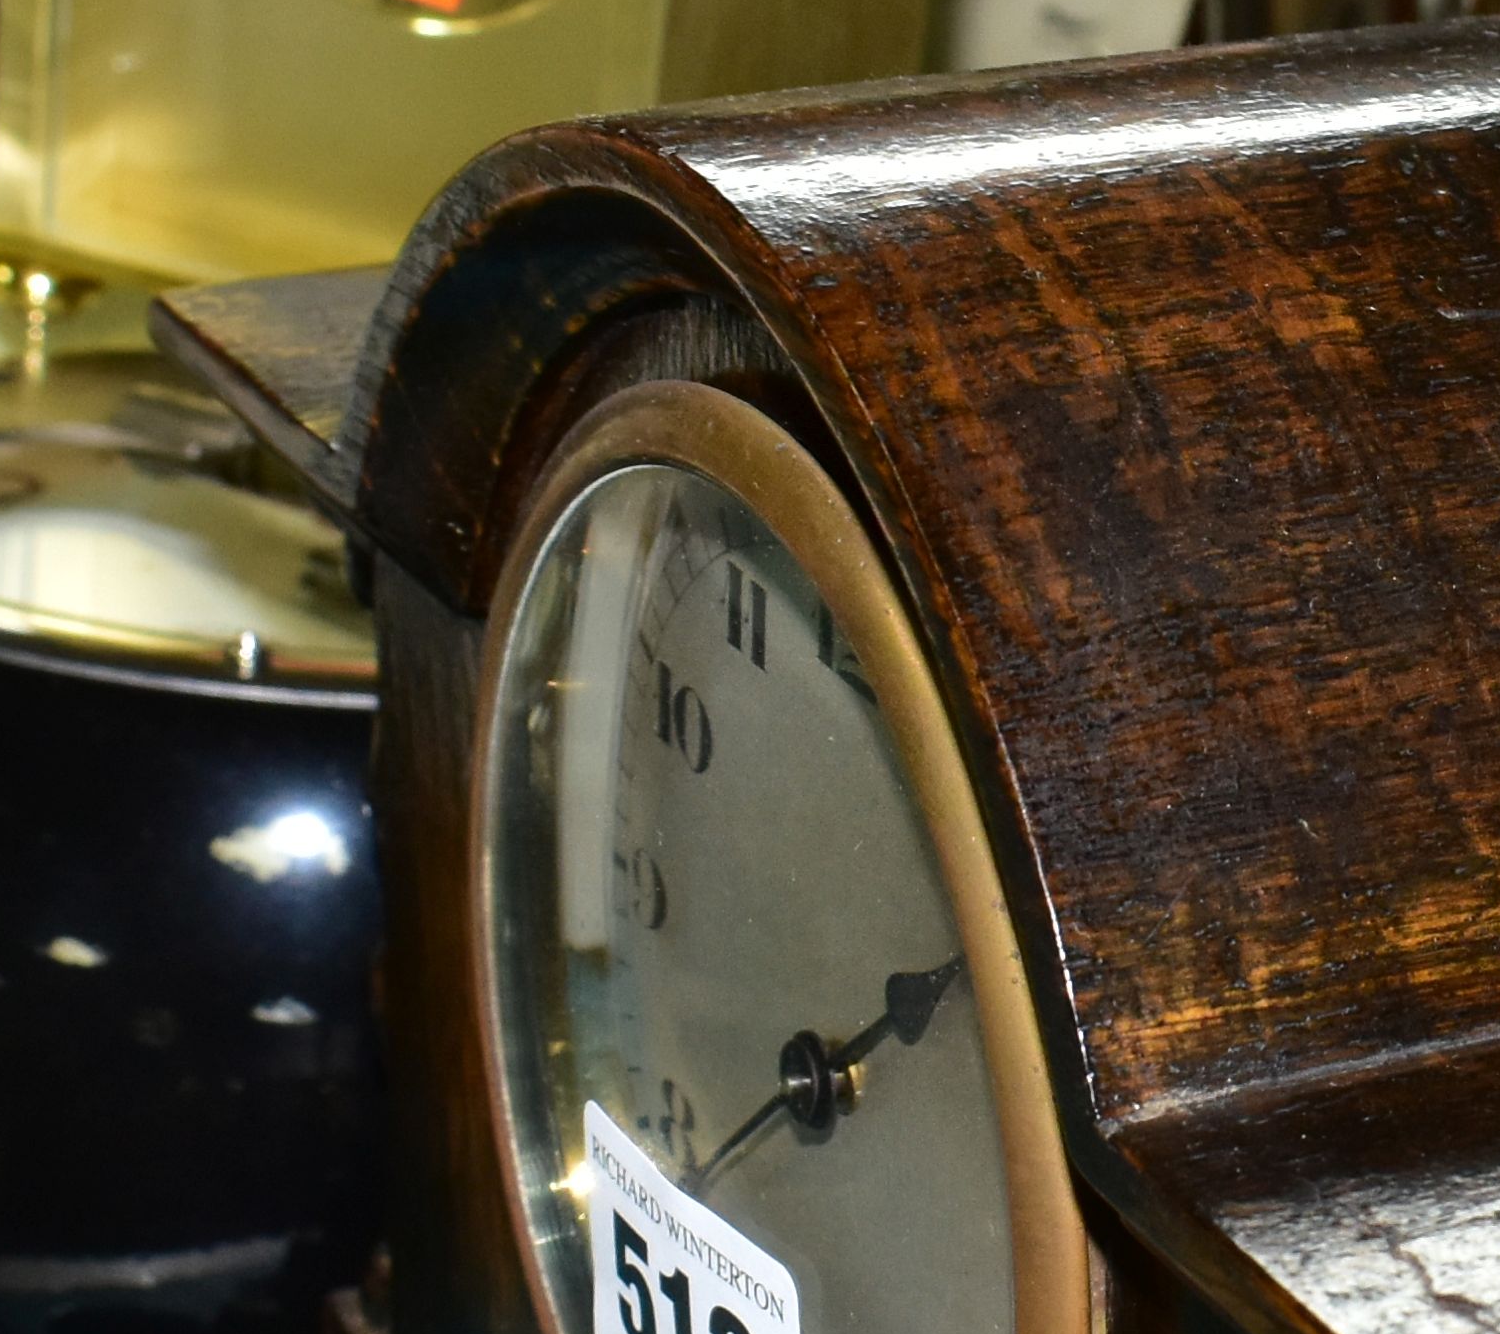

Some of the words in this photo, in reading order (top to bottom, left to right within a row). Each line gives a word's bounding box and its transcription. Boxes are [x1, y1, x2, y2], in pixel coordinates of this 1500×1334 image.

[726, 559, 768, 674] 11
[656, 659, 713, 775] 10
[592, 1134, 662, 1225] RICHARD
[665, 1209, 785, 1324] WINTERTON
